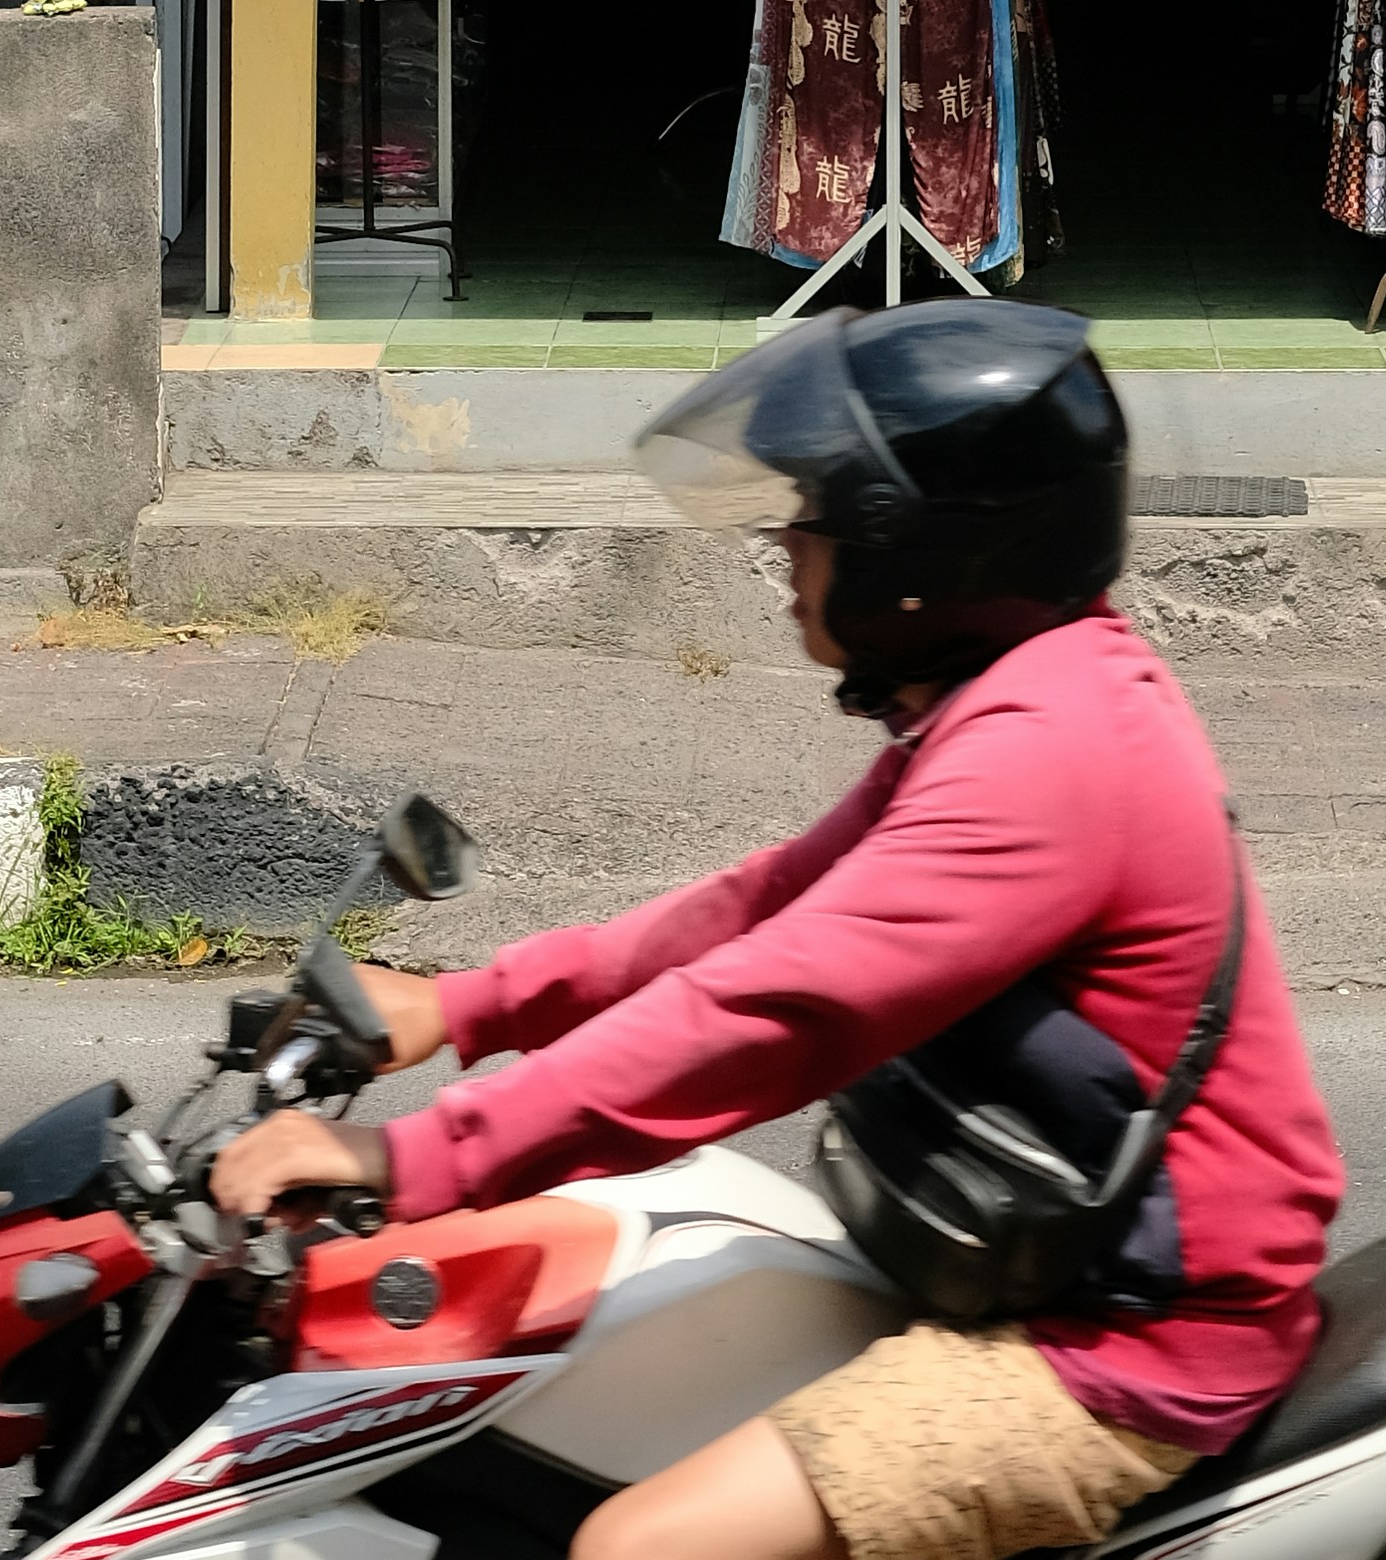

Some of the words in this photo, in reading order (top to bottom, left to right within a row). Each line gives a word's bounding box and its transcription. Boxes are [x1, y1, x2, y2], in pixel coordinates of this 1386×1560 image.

[822, 13, 862, 64] 龍
[937, 73, 975, 125] 龍
[815, 155, 854, 203] 龍
